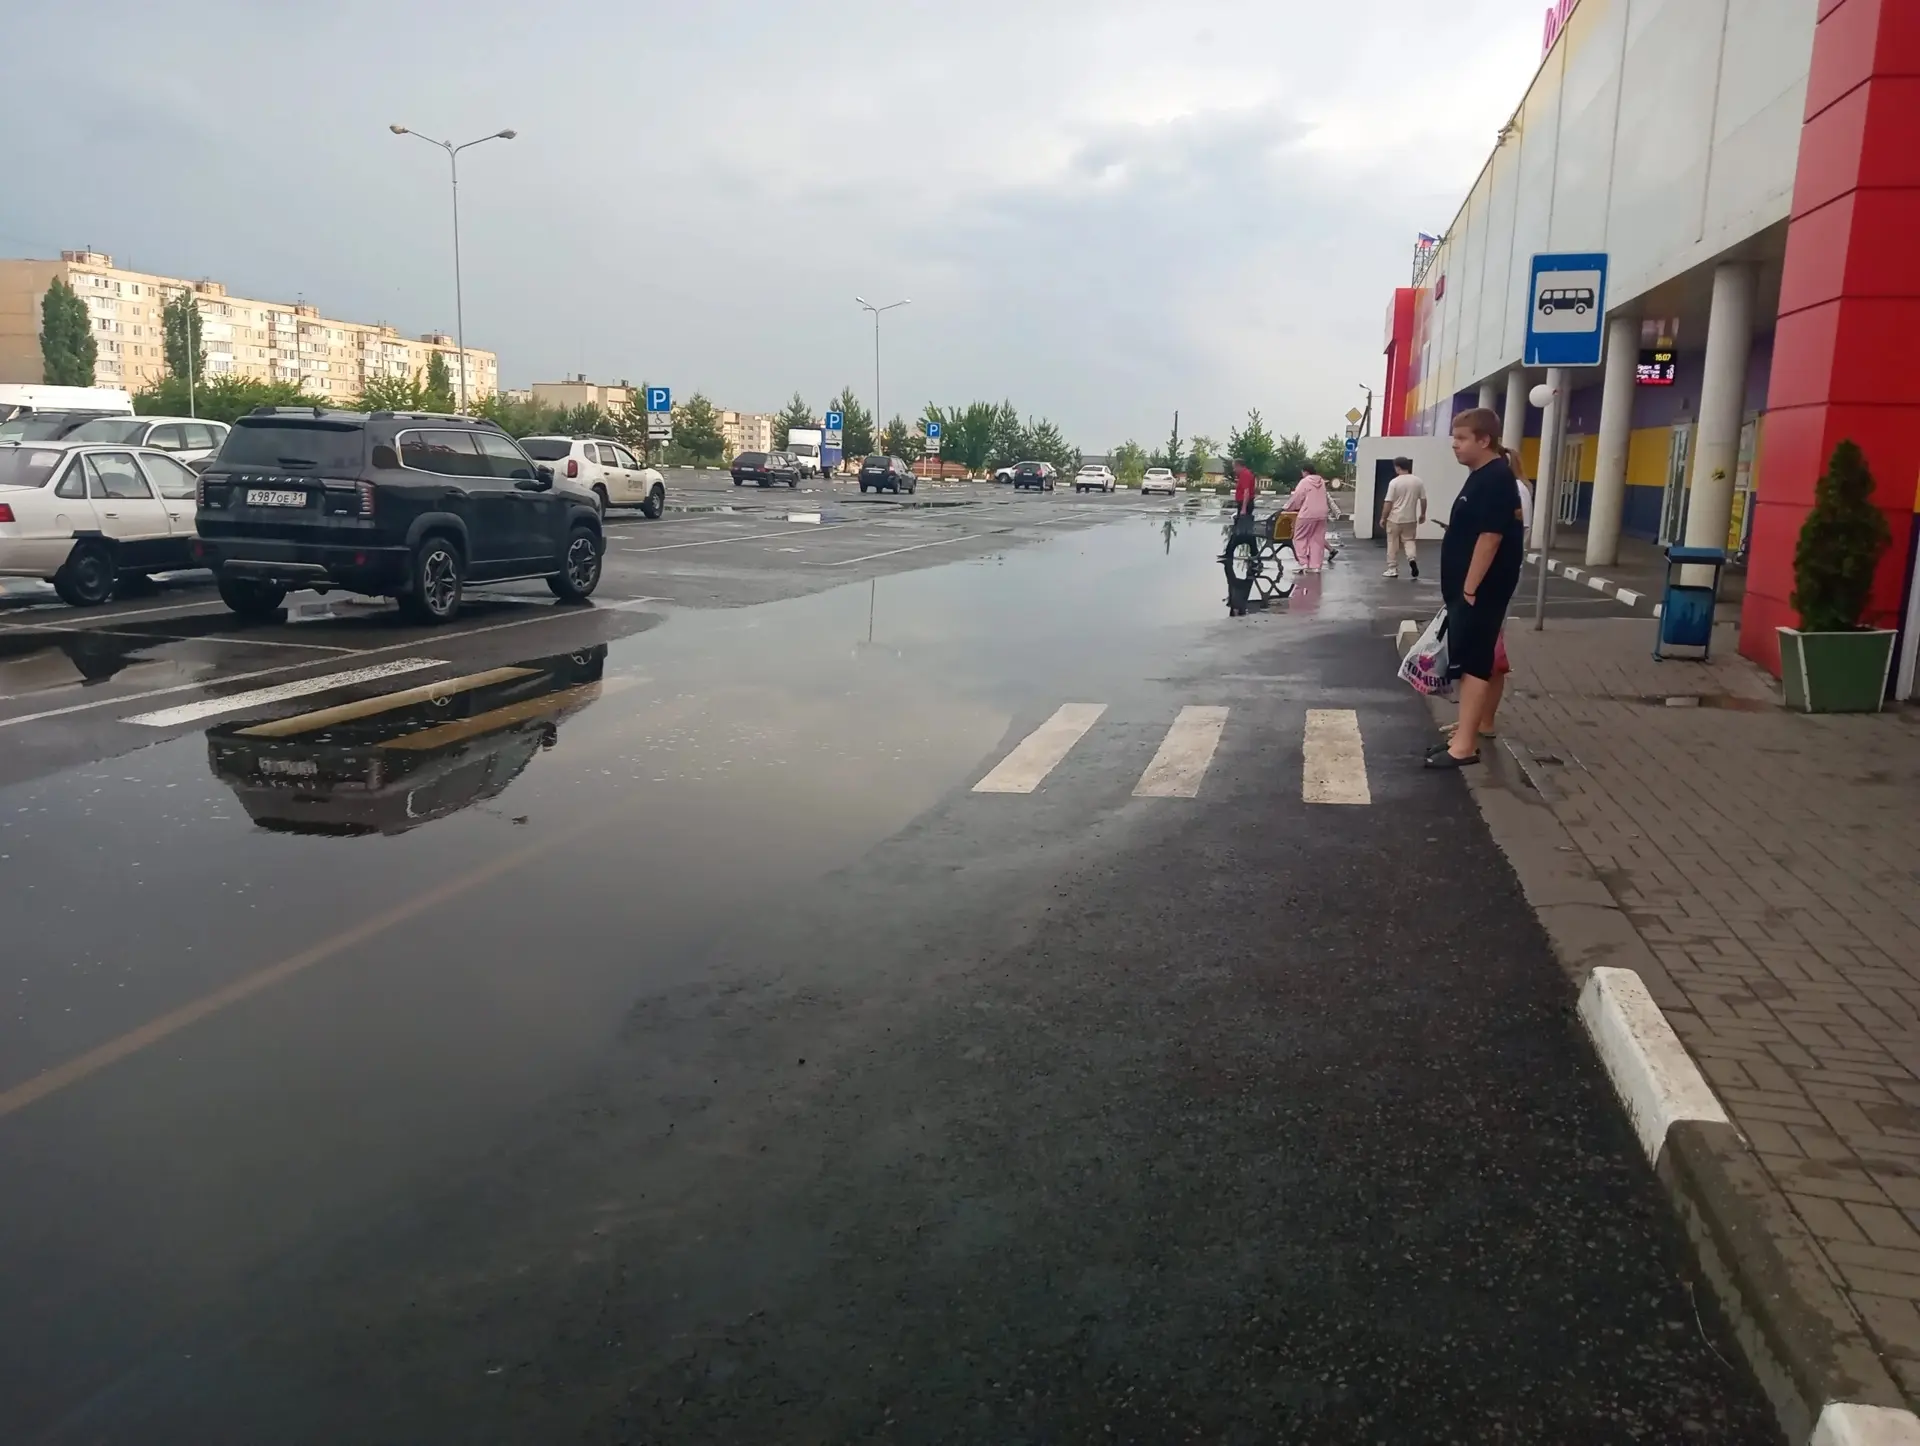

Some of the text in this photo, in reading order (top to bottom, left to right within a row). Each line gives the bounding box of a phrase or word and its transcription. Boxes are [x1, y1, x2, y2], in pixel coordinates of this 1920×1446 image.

[653, 390, 666, 409] P
[830, 414, 840, 428] P
[930, 424, 938, 436] P
